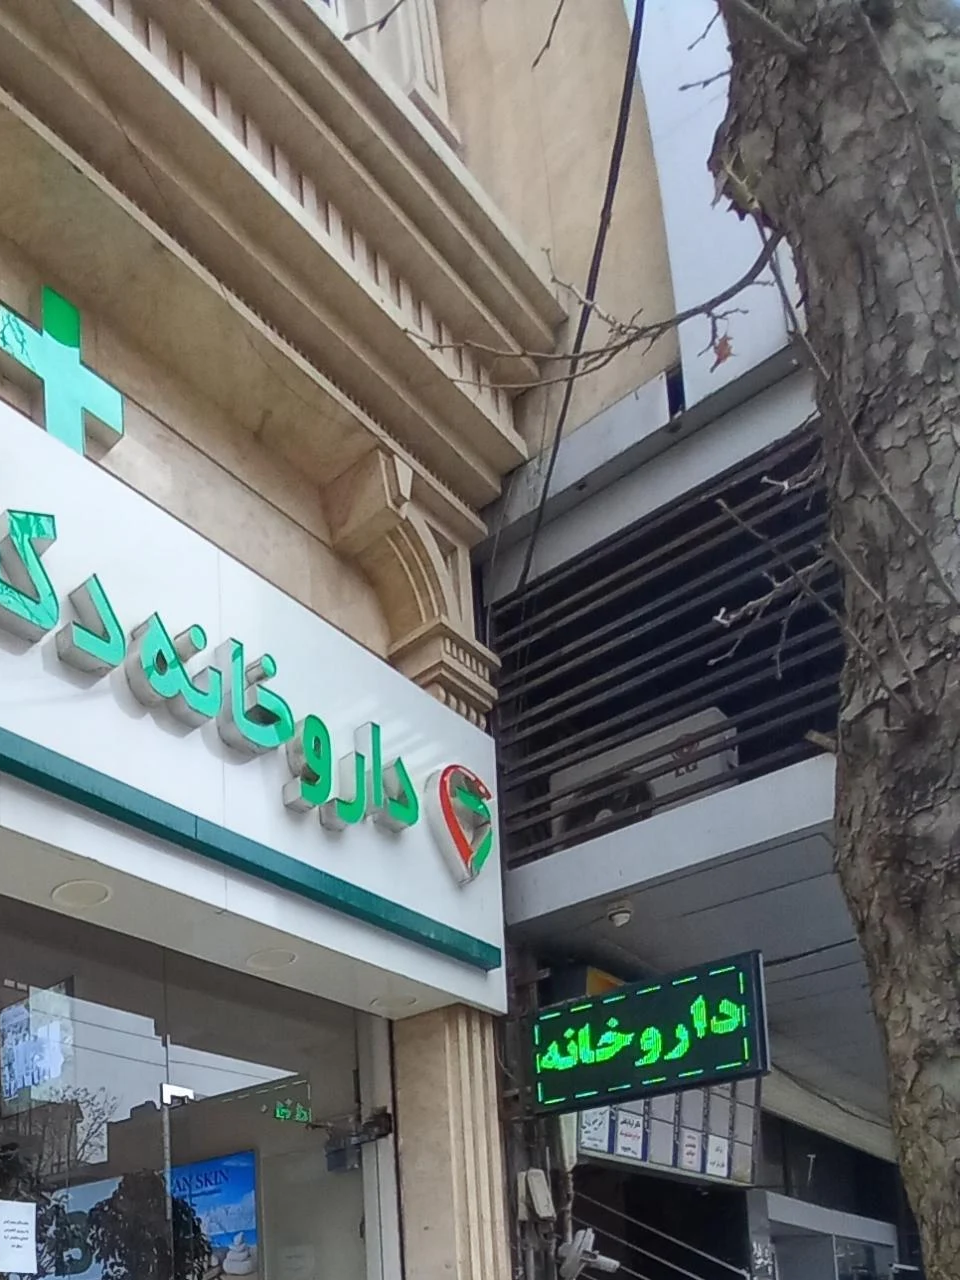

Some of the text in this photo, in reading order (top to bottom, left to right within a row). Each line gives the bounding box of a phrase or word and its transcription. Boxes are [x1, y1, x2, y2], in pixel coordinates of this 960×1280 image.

[137, 611, 419, 825] داروخانه
[540, 995, 741, 1070] داروخانه
[195, 1168, 230, 1189] SKIN
